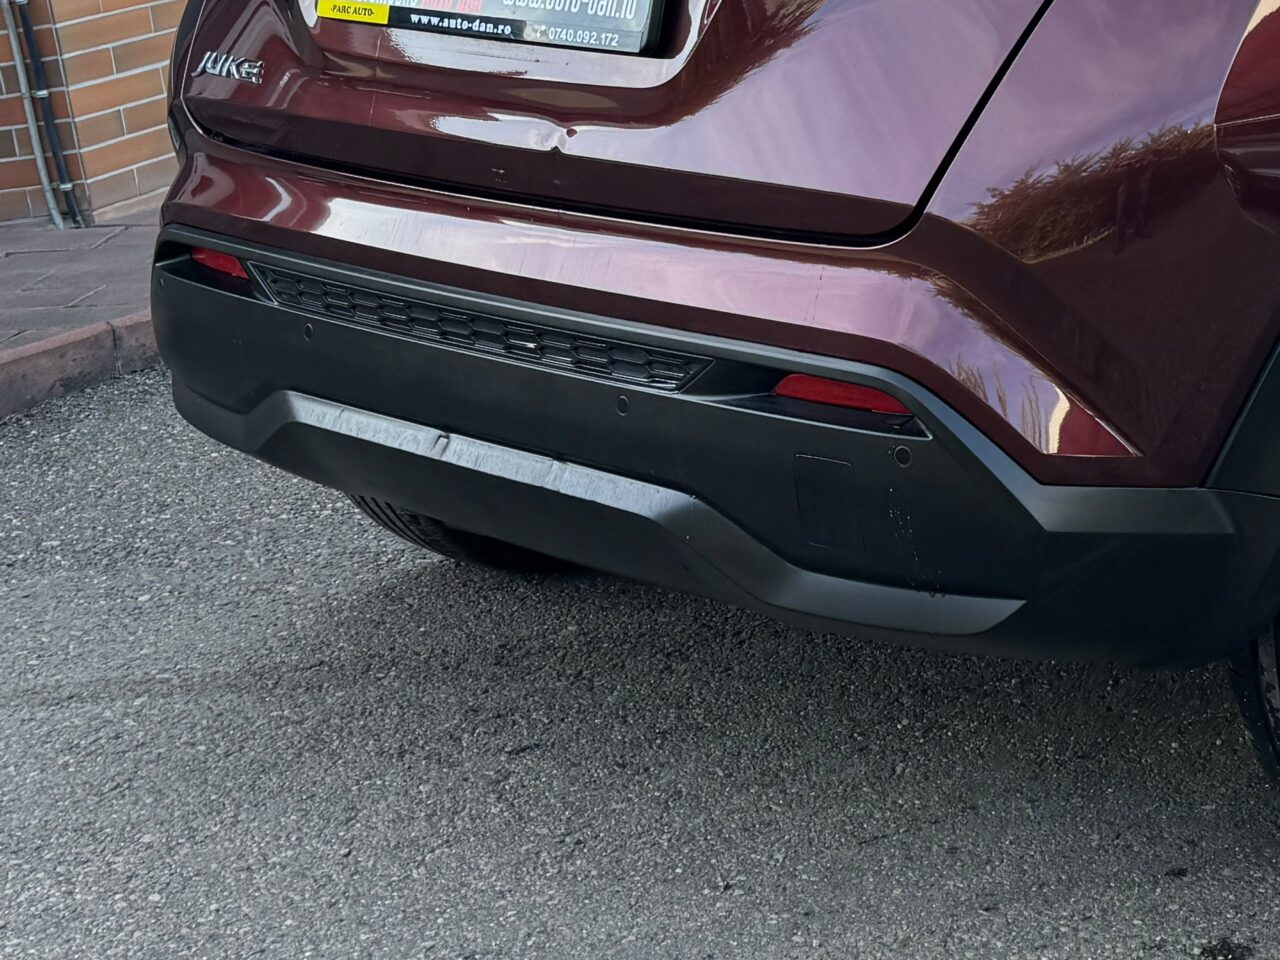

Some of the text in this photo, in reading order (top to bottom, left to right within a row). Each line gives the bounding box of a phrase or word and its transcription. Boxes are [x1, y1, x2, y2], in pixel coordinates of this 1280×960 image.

[410, 13, 512, 35] www.auto-dan.ro
[549, 27, 619, 47] 0740.092.172
[191, 51, 264, 85] JUKE
